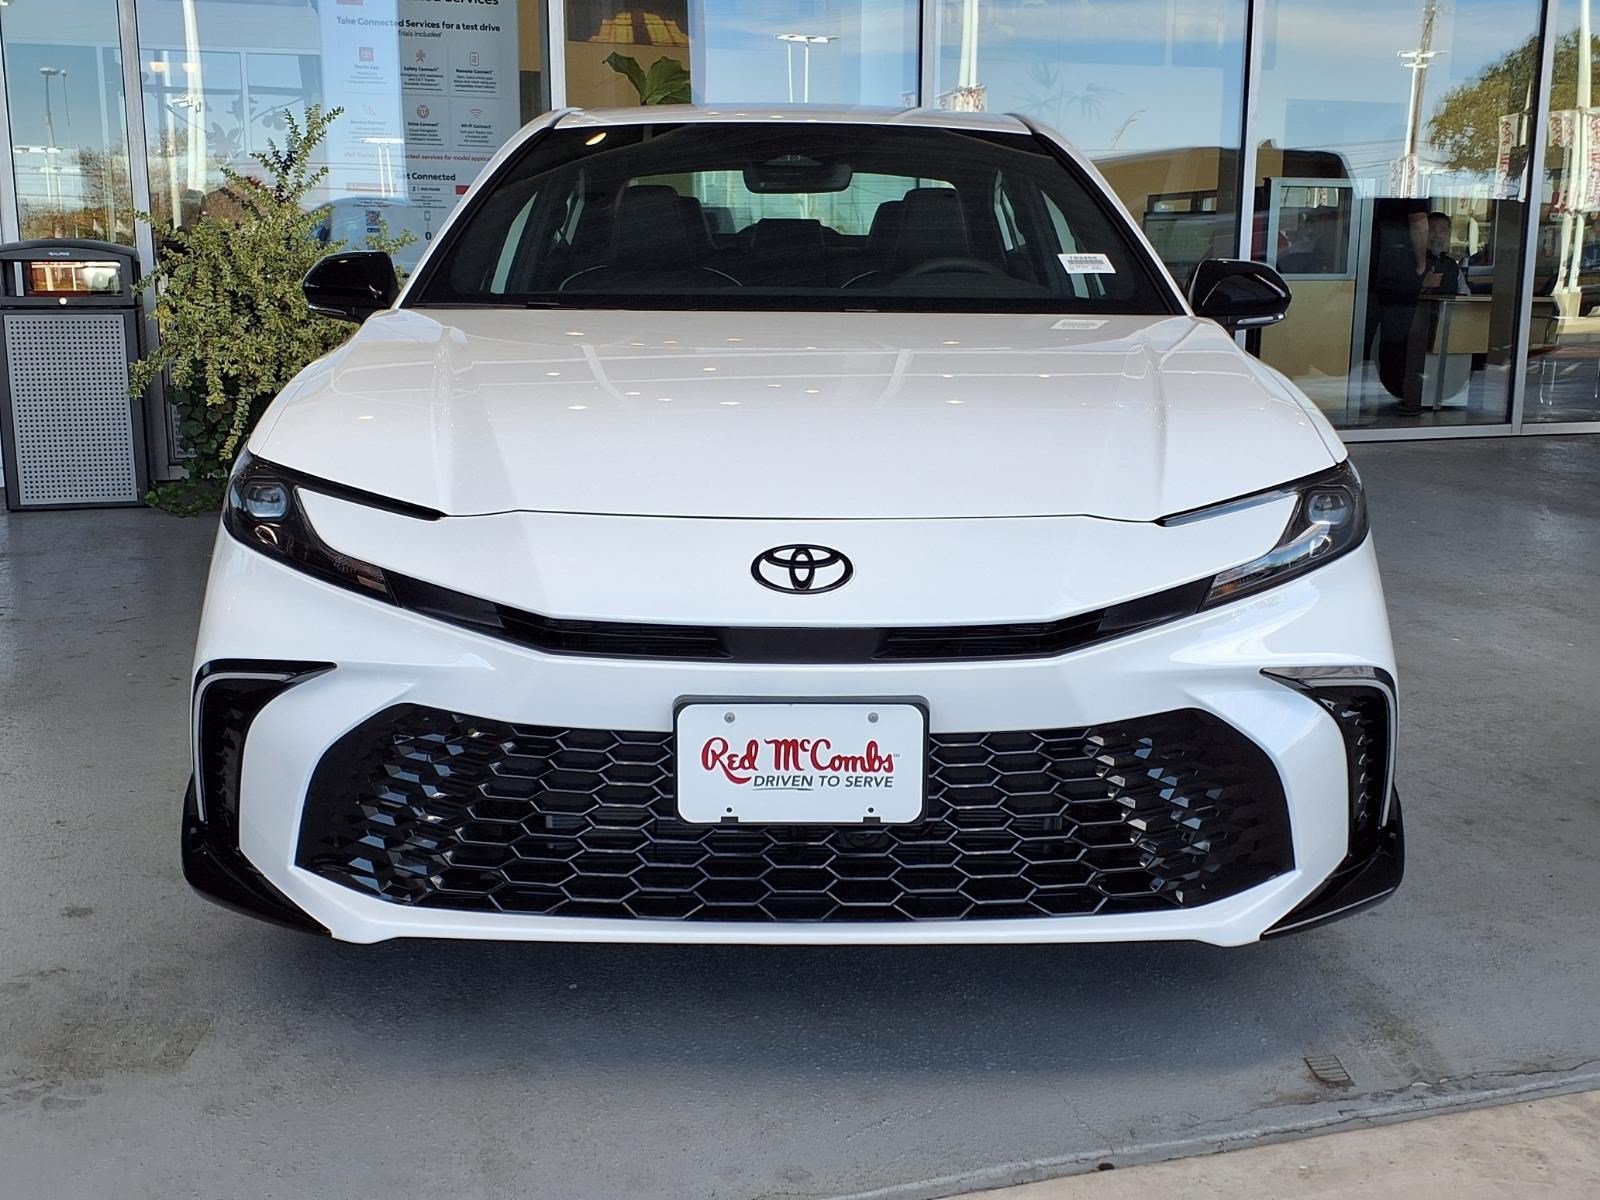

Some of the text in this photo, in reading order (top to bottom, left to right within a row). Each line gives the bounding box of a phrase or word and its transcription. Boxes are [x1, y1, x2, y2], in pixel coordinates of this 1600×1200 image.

[336, 16, 356, 25] Take
[357, 17, 404, 27] Connected
[406, 20, 440, 28] Services
[442, 21, 454, 29] for
[462, 23, 478, 31] test
[480, 24, 500, 32] drive
[411, 172, 456, 181] Connected
[701, 736, 759, 785] Red
[753, 775, 894, 788] DRIVEN TO SERVE
